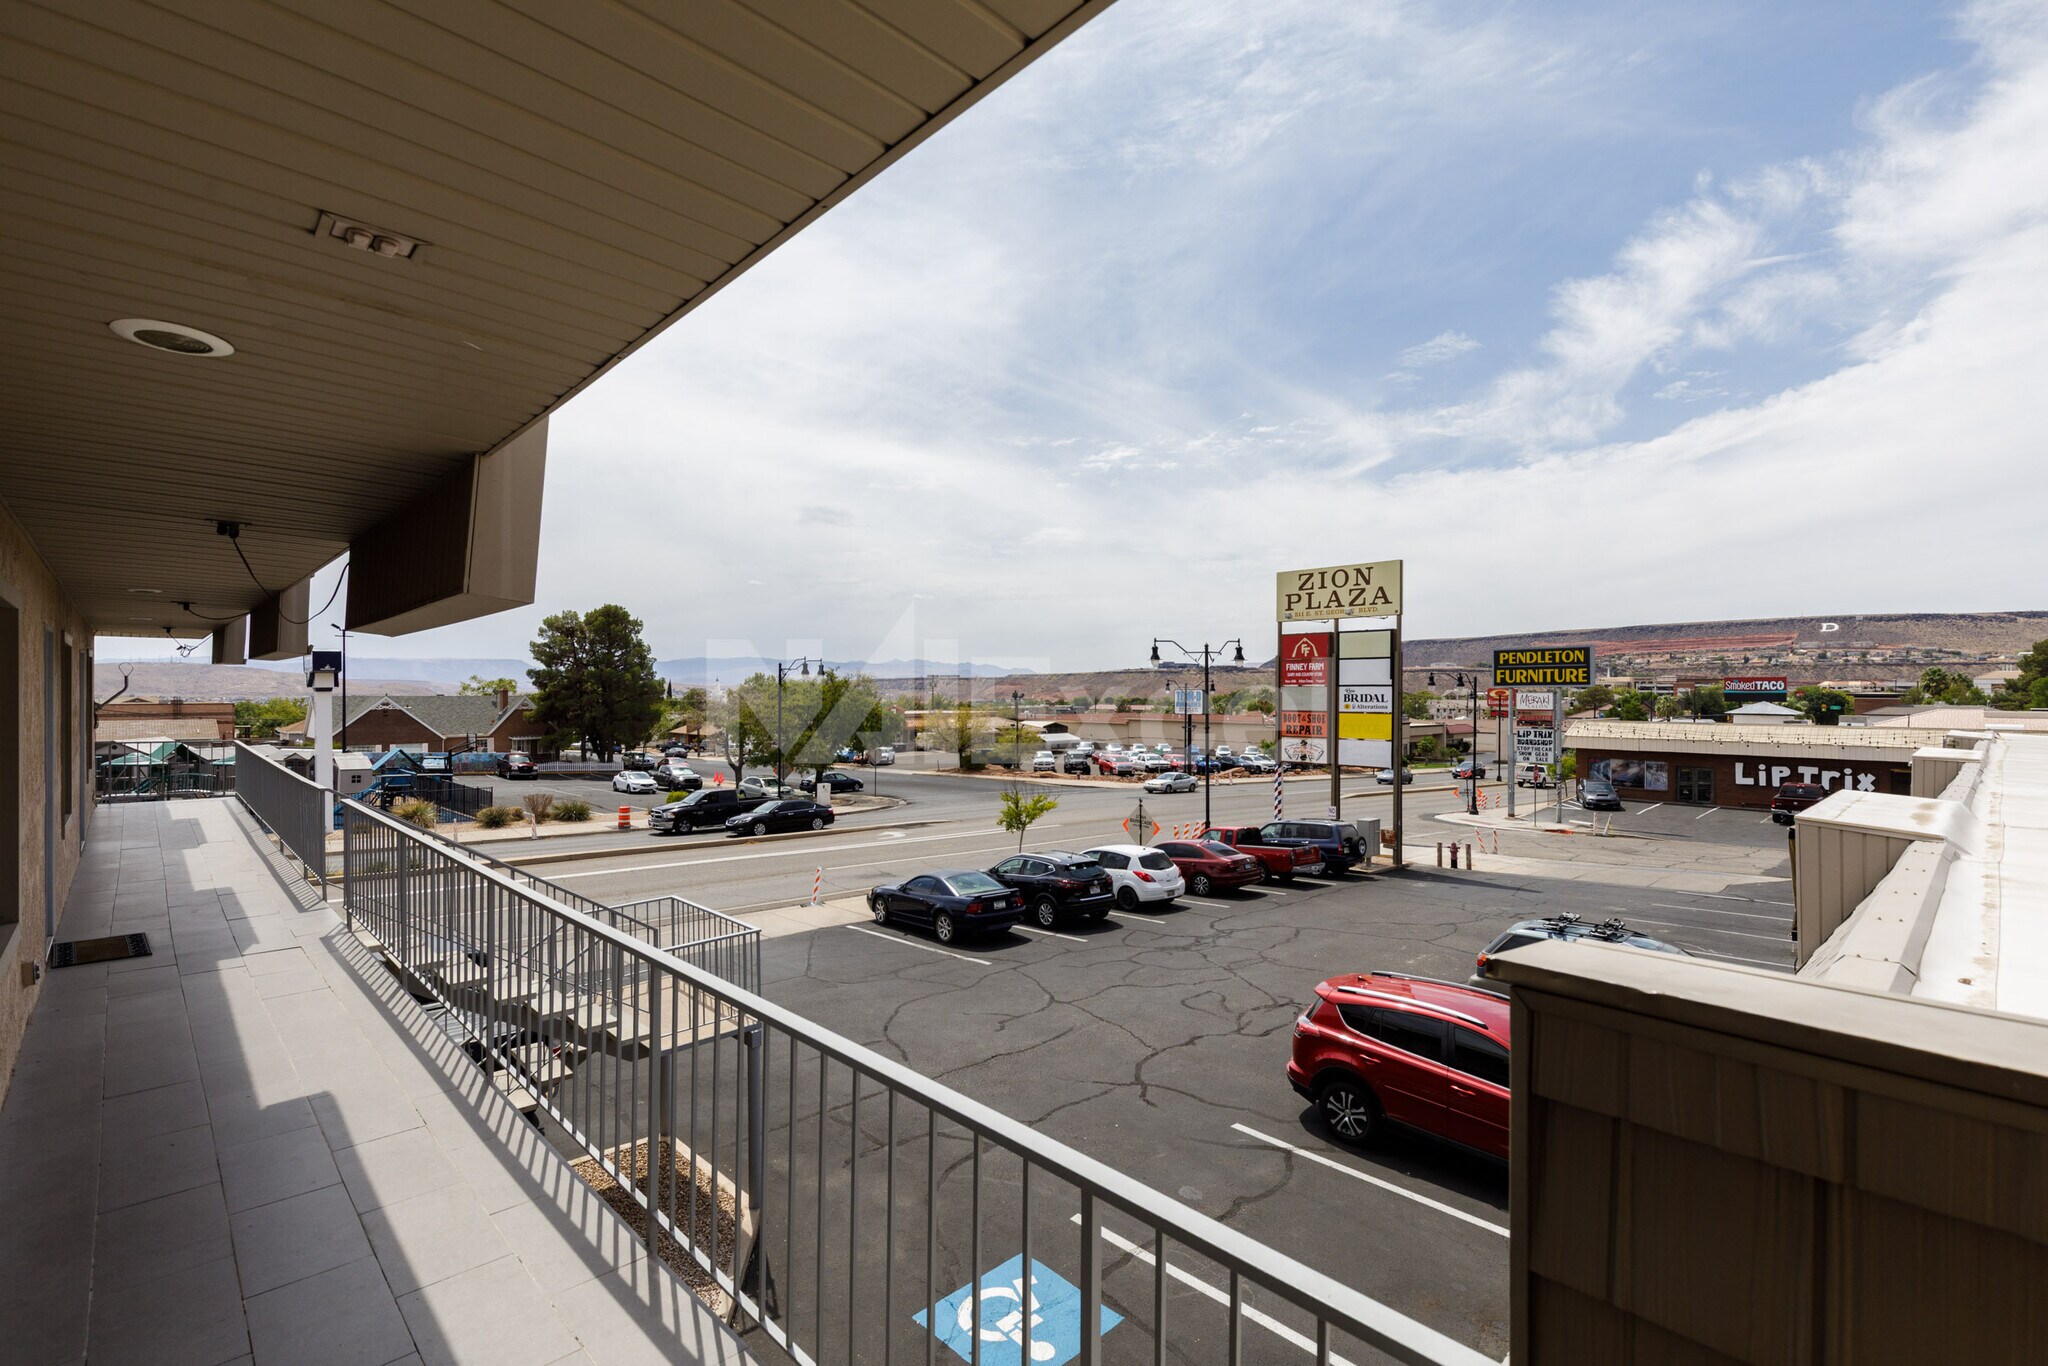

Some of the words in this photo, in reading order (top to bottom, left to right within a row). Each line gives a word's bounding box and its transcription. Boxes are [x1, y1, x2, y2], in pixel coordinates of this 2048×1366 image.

[1298, 566, 1374, 591] ZION
[1285, 586, 1393, 612] PLAZA
[1325, 607, 1354, 616] GEOR
[1499, 649, 1585, 664] PENDLETON
[1285, 663, 1308, 671] FINNEY
[1308, 662, 1325, 671] FARM
[1496, 668, 1588, 683] FURNITURE
[1725, 680, 1755, 691] Smoked
[1755, 680, 1785, 691] TACO
[1343, 693, 1389, 703] BRIDAL
[1283, 713, 1301, 724] BOOT
[1306, 713, 1326, 724] SHOE
[1286, 724, 1323, 736] REPAIR
[1797, 765, 1876, 792] Trix
